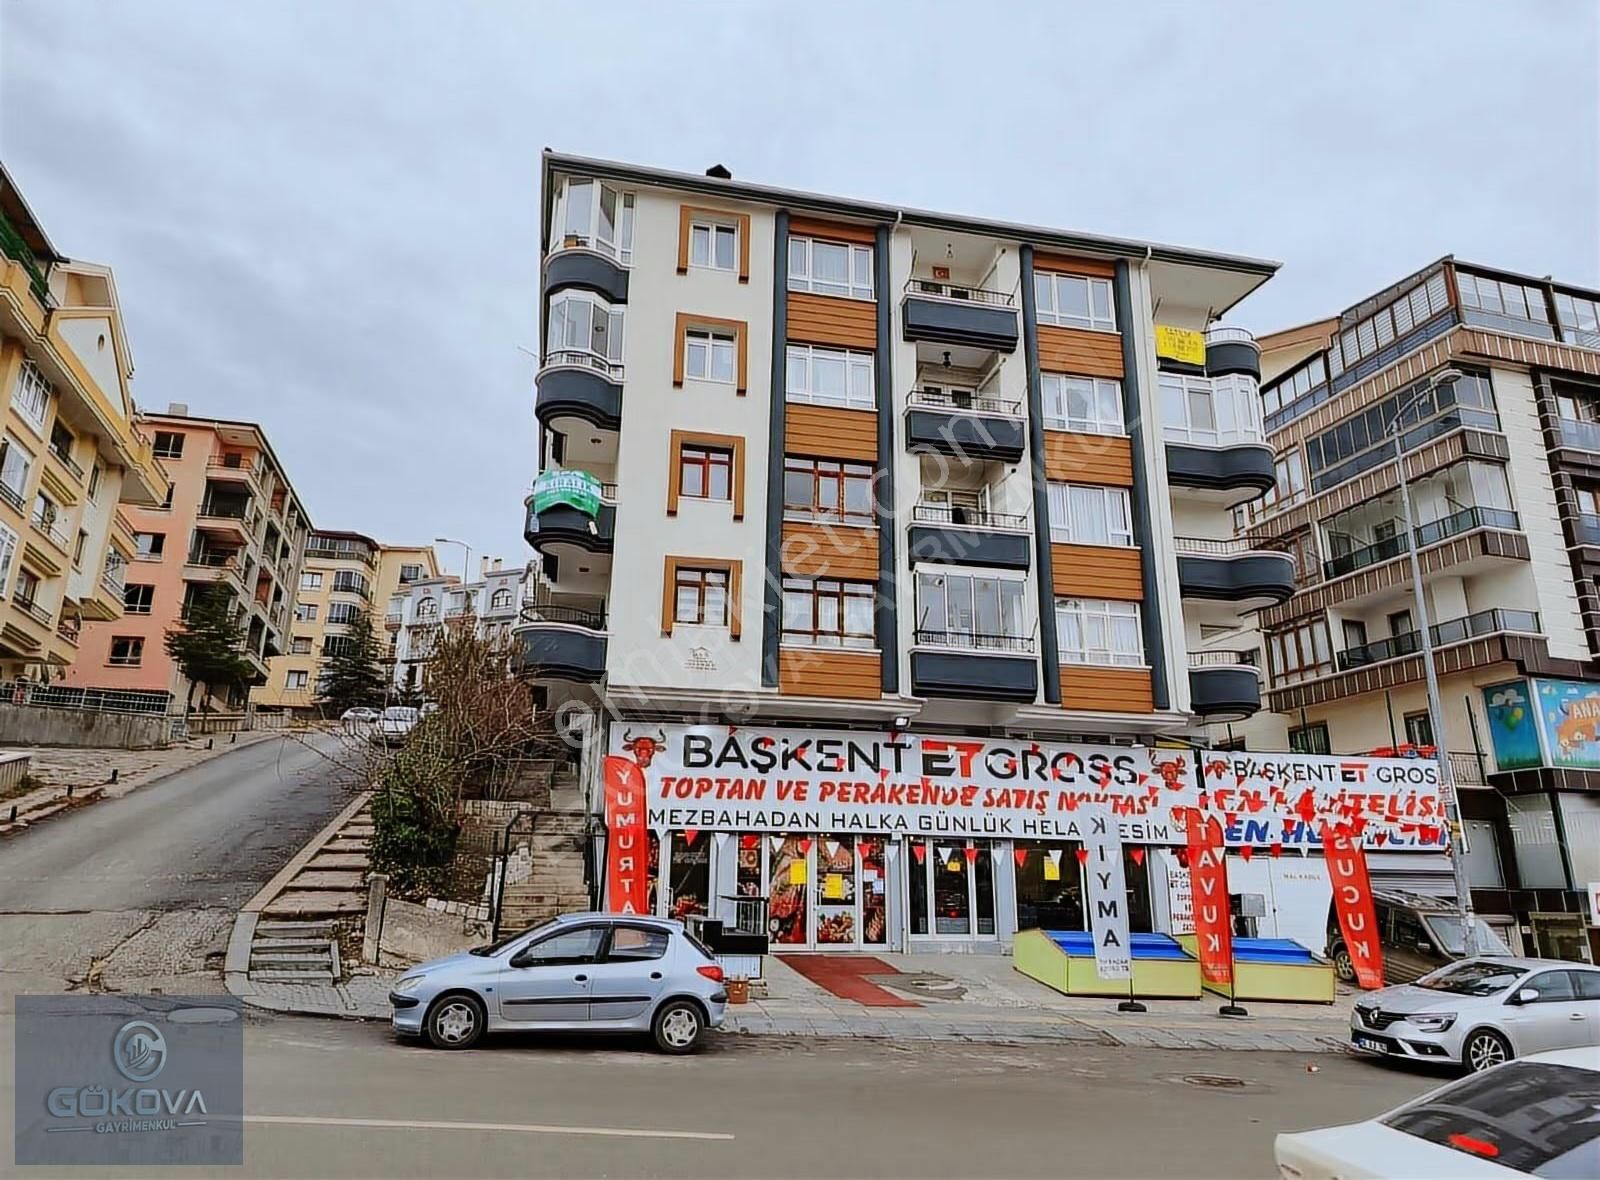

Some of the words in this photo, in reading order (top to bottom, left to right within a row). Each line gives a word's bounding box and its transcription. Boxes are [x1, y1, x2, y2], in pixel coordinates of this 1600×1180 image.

[683, 735, 912, 774] BAŞKENT
[921, 740, 985, 778] ET
[985, 748, 1138, 785] GROSS
[1340, 763, 1369, 782] ET
[661, 777, 766, 800] TOPTAN
[776, 780, 809, 801] VE
[819, 781, 977, 807] PERAKENDE
[983, 788, 1049, 815] SATIŞ
[649, 809, 819, 829] MEZBAHADAN
[832, 813, 908, 830] HALKA
[919, 810, 1012, 833] GÜNLÜK
[1023, 819, 1081, 836] HELA
[1119, 820, 1168, 840] ESİM
[1225, 819, 1269, 842] EN
